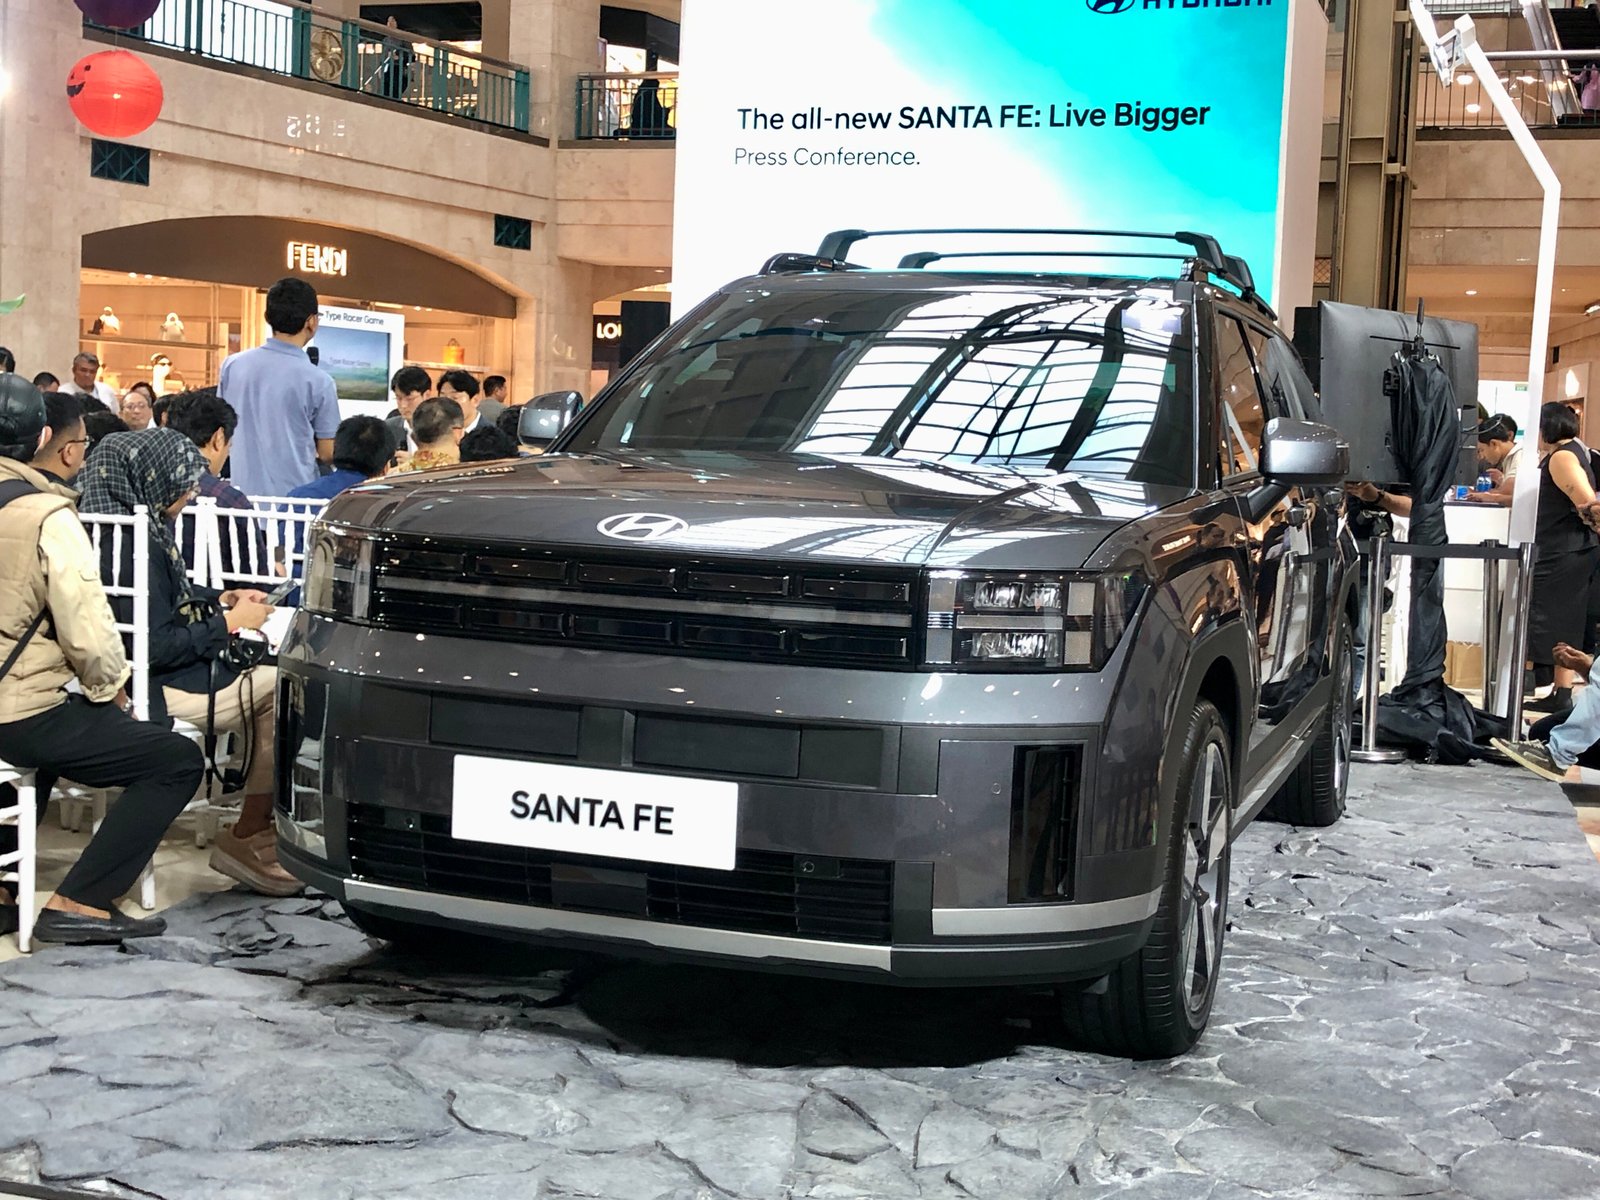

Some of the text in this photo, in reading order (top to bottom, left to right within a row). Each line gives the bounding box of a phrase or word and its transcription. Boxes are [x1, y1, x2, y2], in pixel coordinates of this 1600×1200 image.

[737, 101, 1211, 132] The all-new SANTA FE: Live Bigger
[734, 146, 921, 166] Press Conference.
[286, 240, 348, 277] FENDI
[325, 310, 342, 321] Type
[510, 789, 675, 836] SANTA FE
